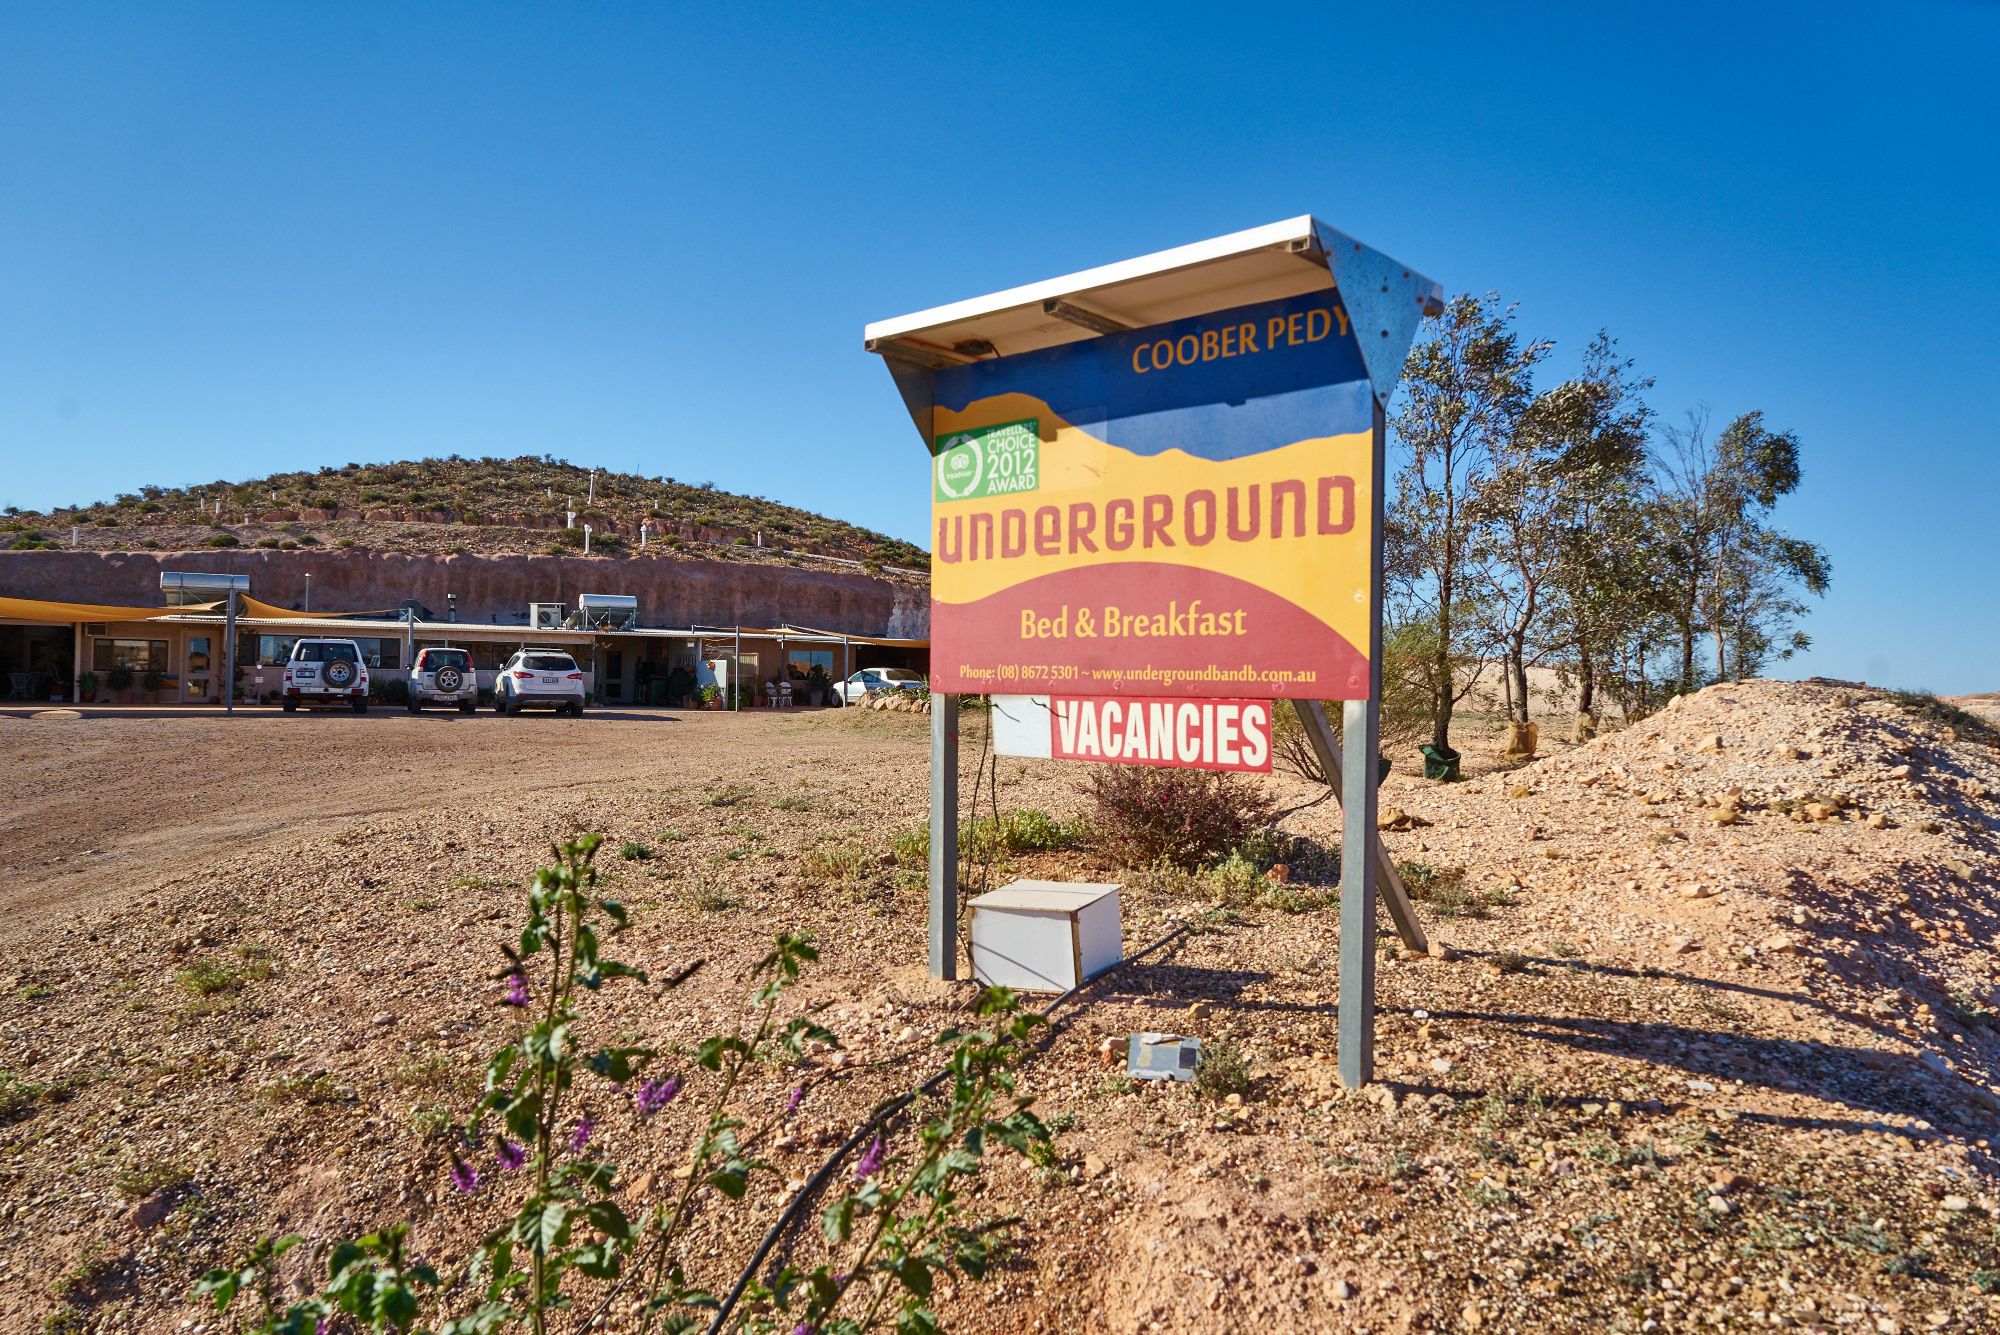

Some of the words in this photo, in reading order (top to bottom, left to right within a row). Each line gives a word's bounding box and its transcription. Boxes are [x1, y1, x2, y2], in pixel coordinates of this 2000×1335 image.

[1132, 322, 1259, 374] COOBER
[1267, 306, 1348, 349] PEDY
[987, 434, 1035, 454] CHOICE
[987, 449, 1035, 479] 2012
[987, 475, 1036, 494] AWARD
[1021, 605, 1068, 639] Bed
[1075, 607, 1098, 638] &
[1104, 600, 1248, 638] Breakfast
[960, 665, 995, 679] Phone:
[997, 664, 1019, 681] (08)
[1021, 665, 1049, 679] 8672
[1051, 665, 1079, 680] 5301
[1092, 664, 1316, 686] www.undergroundbandb.com.au
[1056, 700, 1268, 767] VACANCIES
